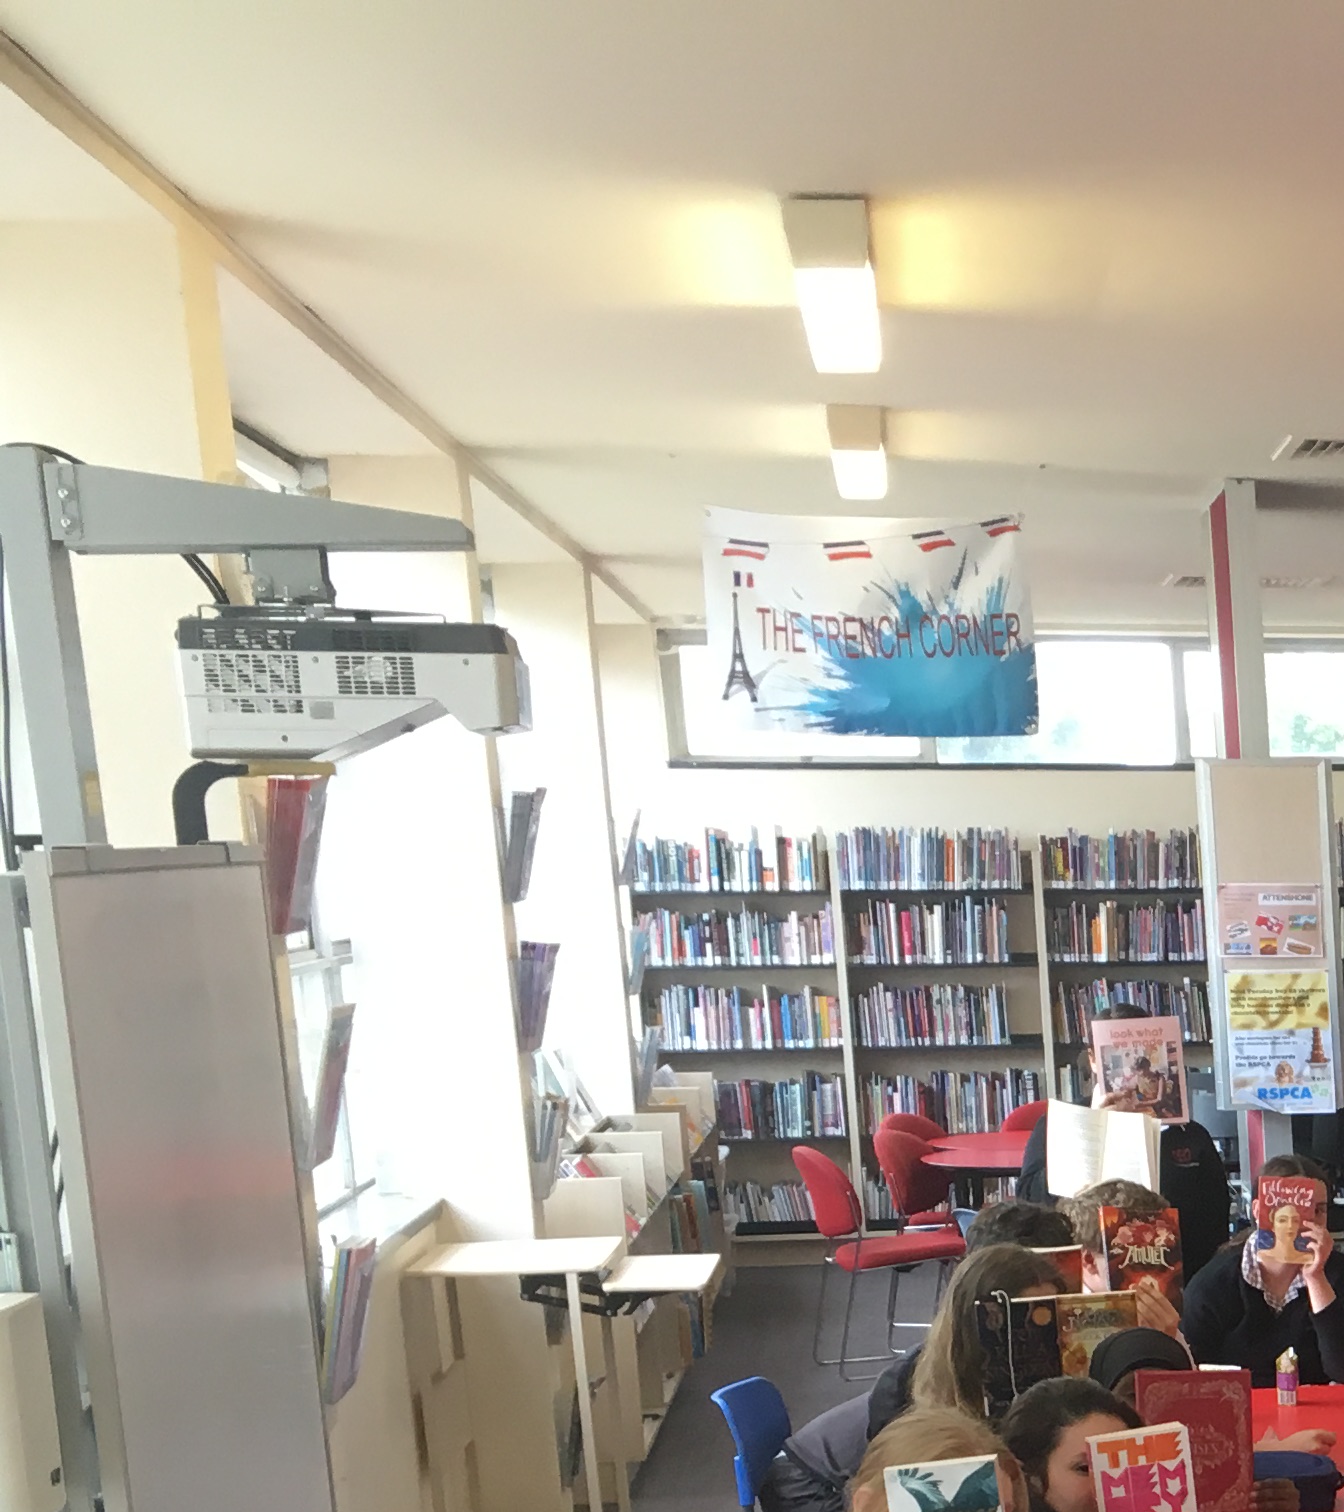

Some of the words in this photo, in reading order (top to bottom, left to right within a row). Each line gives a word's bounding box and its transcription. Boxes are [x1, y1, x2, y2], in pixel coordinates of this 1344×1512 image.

[756, 607, 806, 653] THE
[811, 614, 912, 659] FRENCH
[919, 613, 1022, 658] CORNER
[1110, 1029, 1134, 1038] look
[1136, 1027, 1163, 1037] what
[1113, 1040, 1128, 1048] we
[1132, 1038, 1163, 1048] made
[1257, 1086, 1313, 1099] RSPCA
[1118, 1242, 1175, 1271] AMULET
[1096, 1433, 1184, 1469] THE
